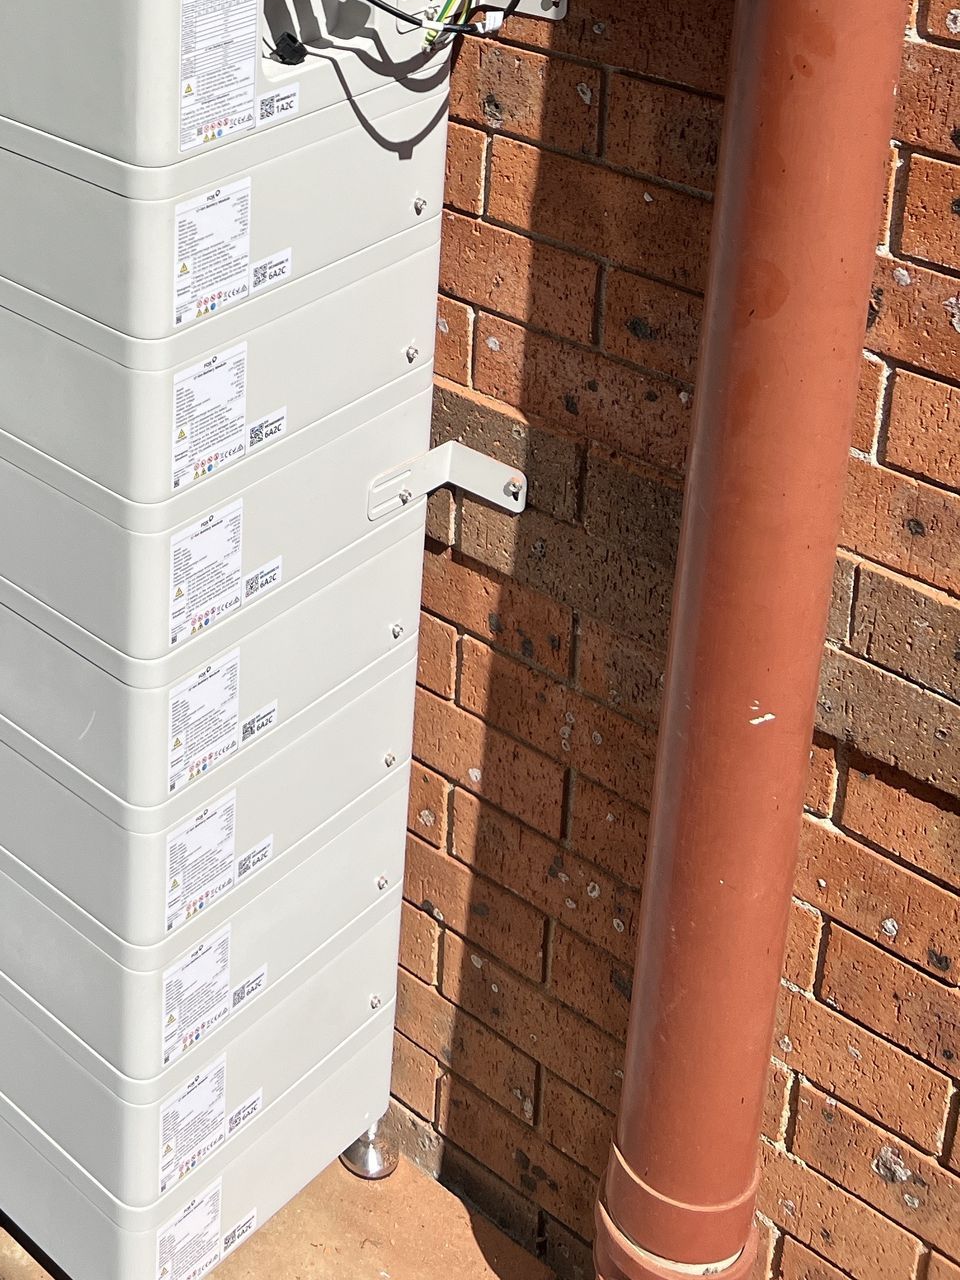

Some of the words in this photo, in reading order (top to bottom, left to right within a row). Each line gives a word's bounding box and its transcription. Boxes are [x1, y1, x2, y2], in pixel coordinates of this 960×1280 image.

[276, 100, 294, 114] 1A2C
[268, 265, 286, 280] 6A2C
[264, 423, 282, 439] 6A2C
[259, 573, 277, 588] 6A2C
[256, 715, 273, 731] 6A2C
[251, 851, 268, 867] 6A2C
[241, 1103, 259, 1121] 6A2C
[236, 1222, 253, 1240] 6A2C
